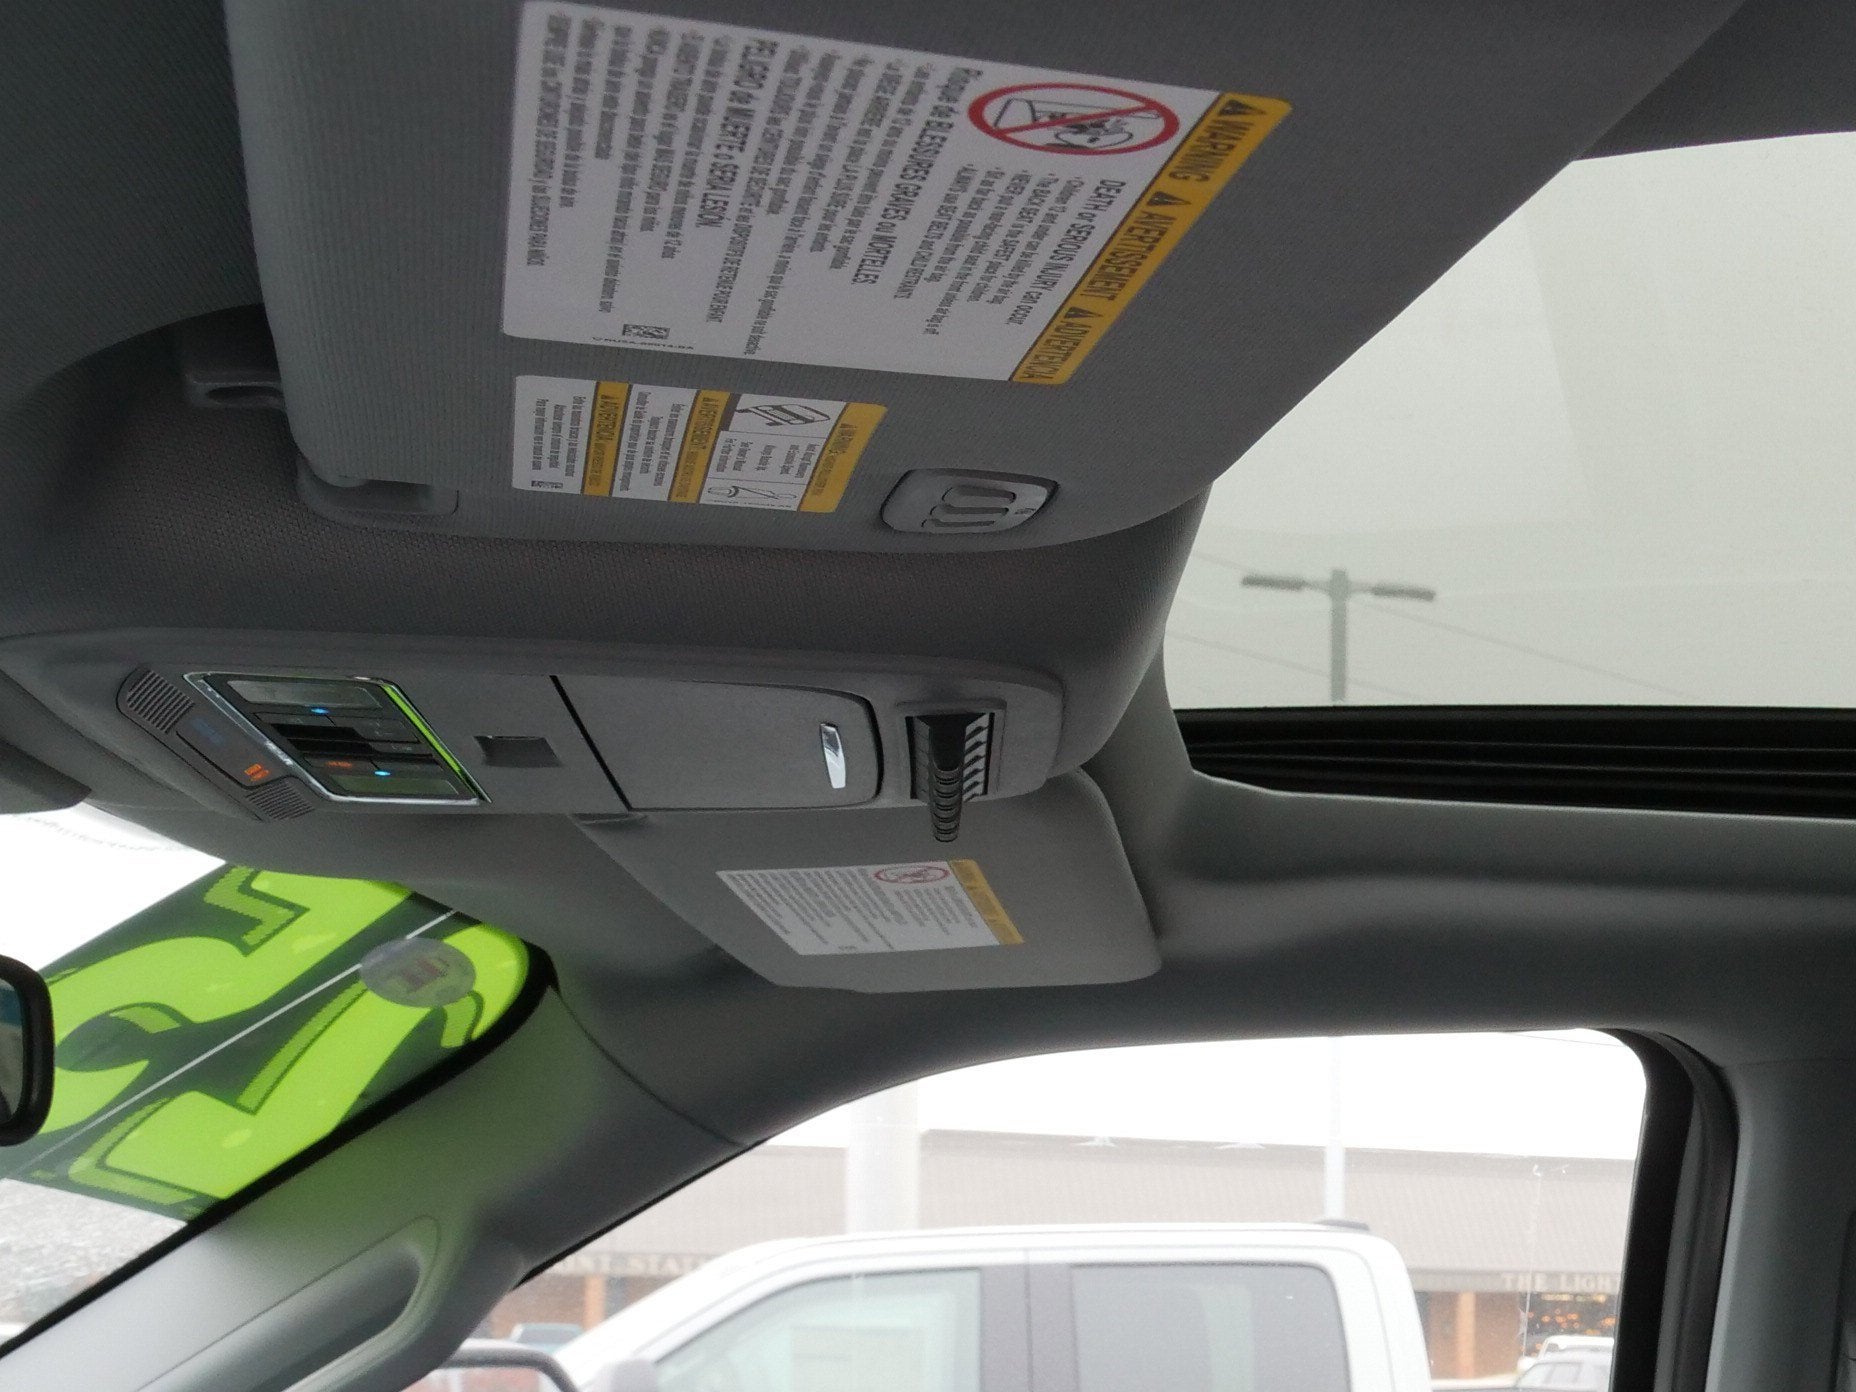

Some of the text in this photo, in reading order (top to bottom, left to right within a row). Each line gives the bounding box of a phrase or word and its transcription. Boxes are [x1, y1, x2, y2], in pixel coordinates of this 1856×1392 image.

[731, 37, 779, 90] PELIGRO
[727, 89, 759, 105] de
[714, 105, 756, 152] MUERTE
[712, 152, 733, 160] o
[898, 119, 954, 182] BLESSURES
[1166, 117, 1254, 183] WARNING
[703, 161, 740, 192] SERIA
[880, 182, 924, 221] GRAVES
[1080, 179, 1127, 212] DEATH
[874, 221, 897, 233] ou
[1073, 211, 1100, 222] or
[1047, 222, 1097, 261] SERIOUS
[1077, 210, 1180, 300] AVERTISSEMENT
[1027, 262, 1069, 291] INJURY
[1018, 290, 1044, 304] can
[1018, 320, 1095, 380] ADVERTENCIA
[1501, 1273, 1614, 1291] THE LIGH
